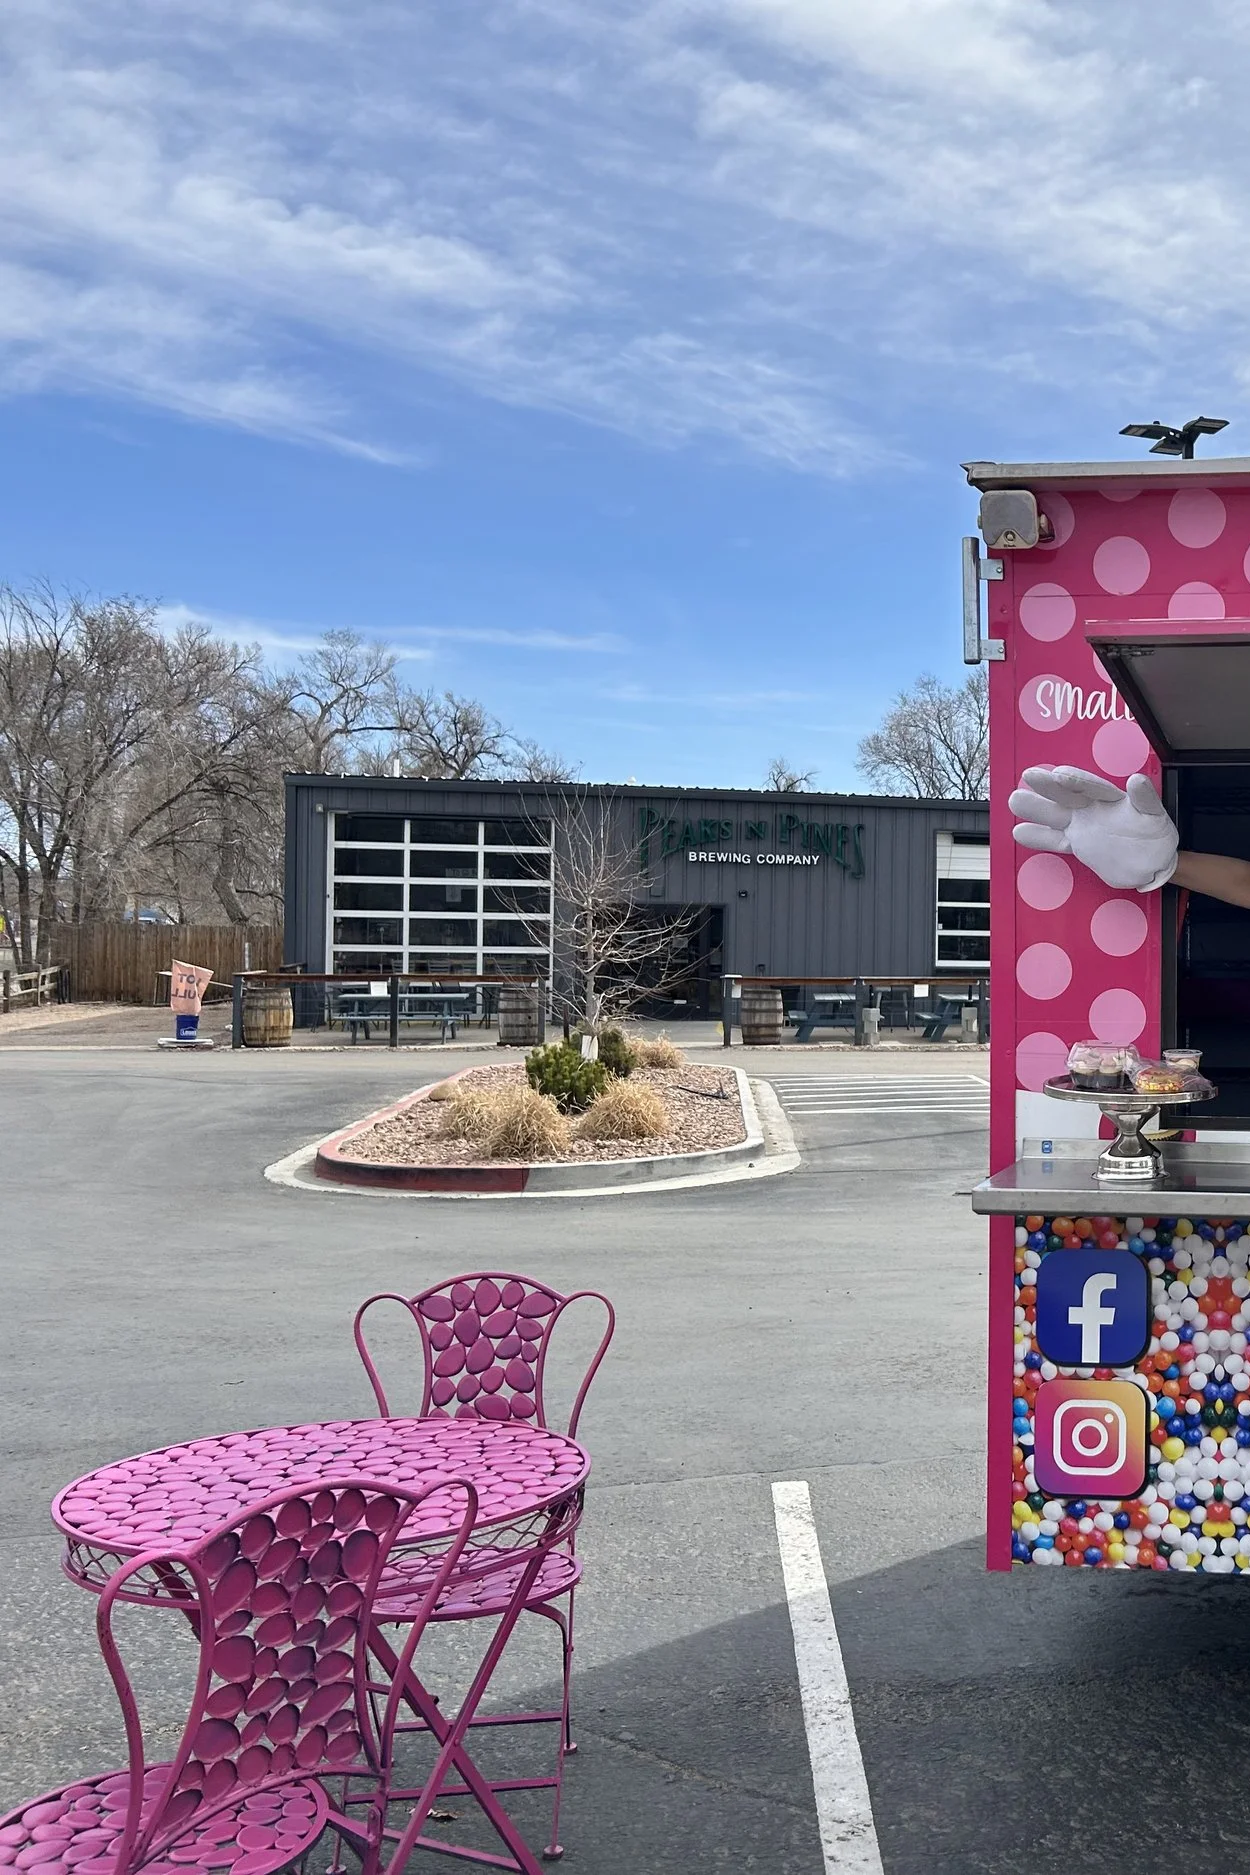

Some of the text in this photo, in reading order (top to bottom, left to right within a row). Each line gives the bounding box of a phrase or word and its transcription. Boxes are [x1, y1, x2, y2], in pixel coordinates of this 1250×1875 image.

[688, 851, 820, 865] BREWING COMPANY
[779, 813, 866, 880] PINES
